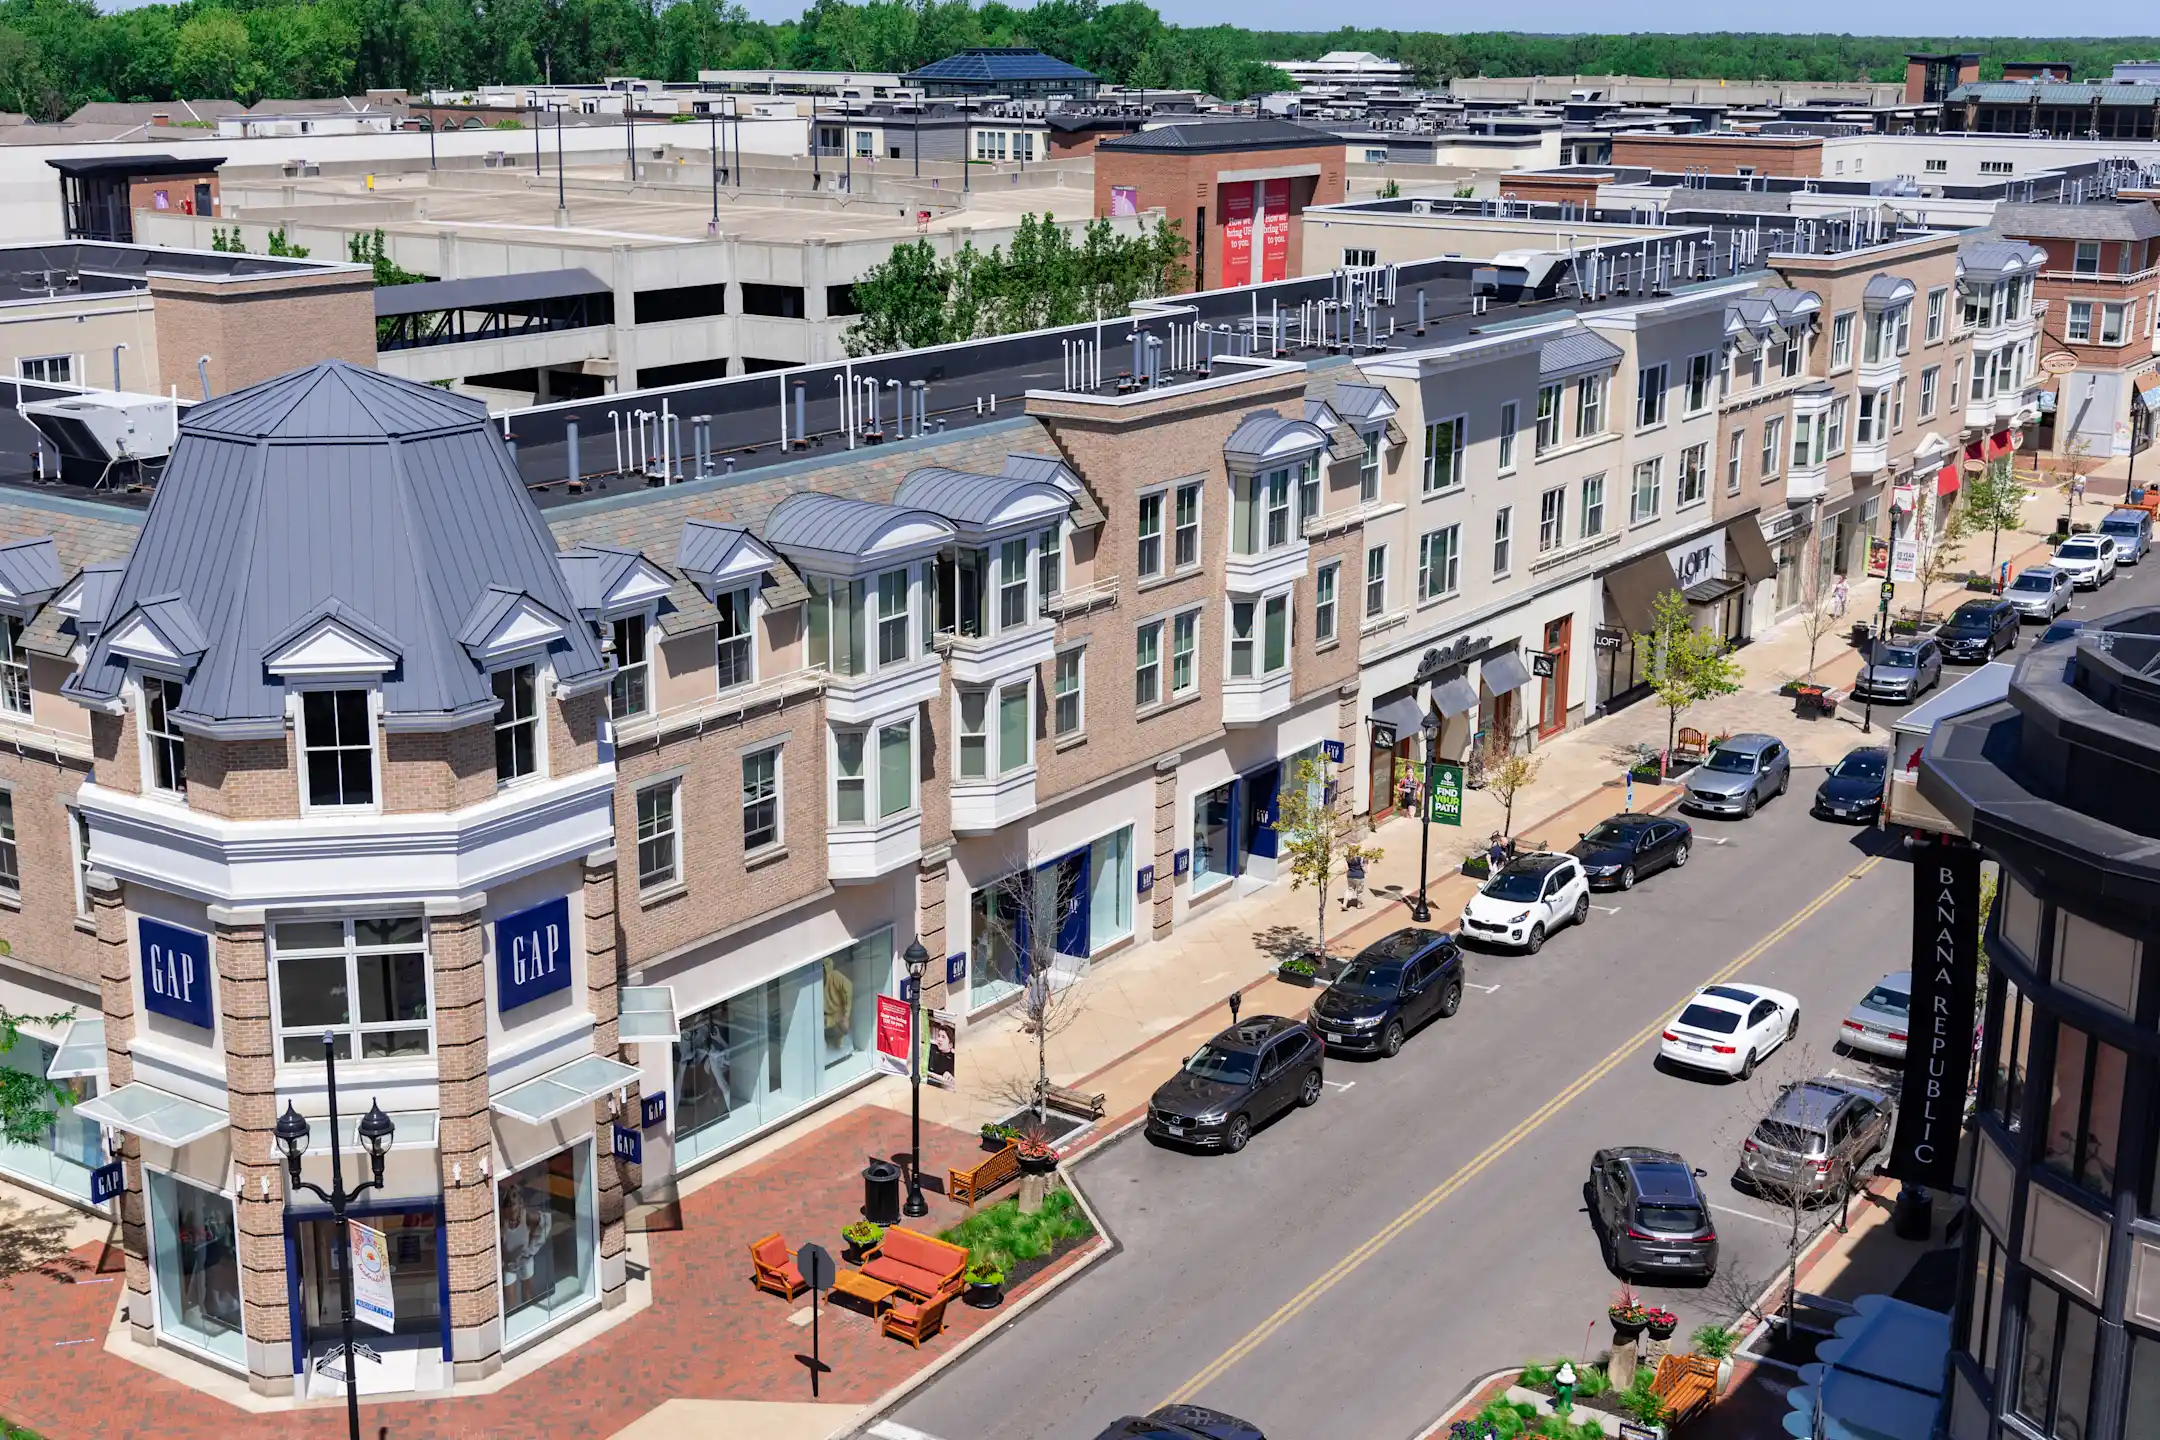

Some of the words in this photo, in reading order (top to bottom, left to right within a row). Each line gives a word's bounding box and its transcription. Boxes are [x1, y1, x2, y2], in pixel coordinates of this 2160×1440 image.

[1679, 545, 1713, 580] LOFT
[1596, 636, 1621, 648] LOFT
[1434, 794, 1461, 806] YOUR
[1436, 787, 1459, 798] FIND
[1434, 802, 1459, 814] PATH
[1935, 866, 1956, 985] BANANA
[512, 923, 560, 986] GAP
[150, 943, 195, 1003] GAP
[1914, 995, 1951, 1164] REPUBLIC
[648, 1099, 664, 1121] GAP
[617, 1134, 635, 1157] GAP
[98, 1170, 120, 1196] GAP
